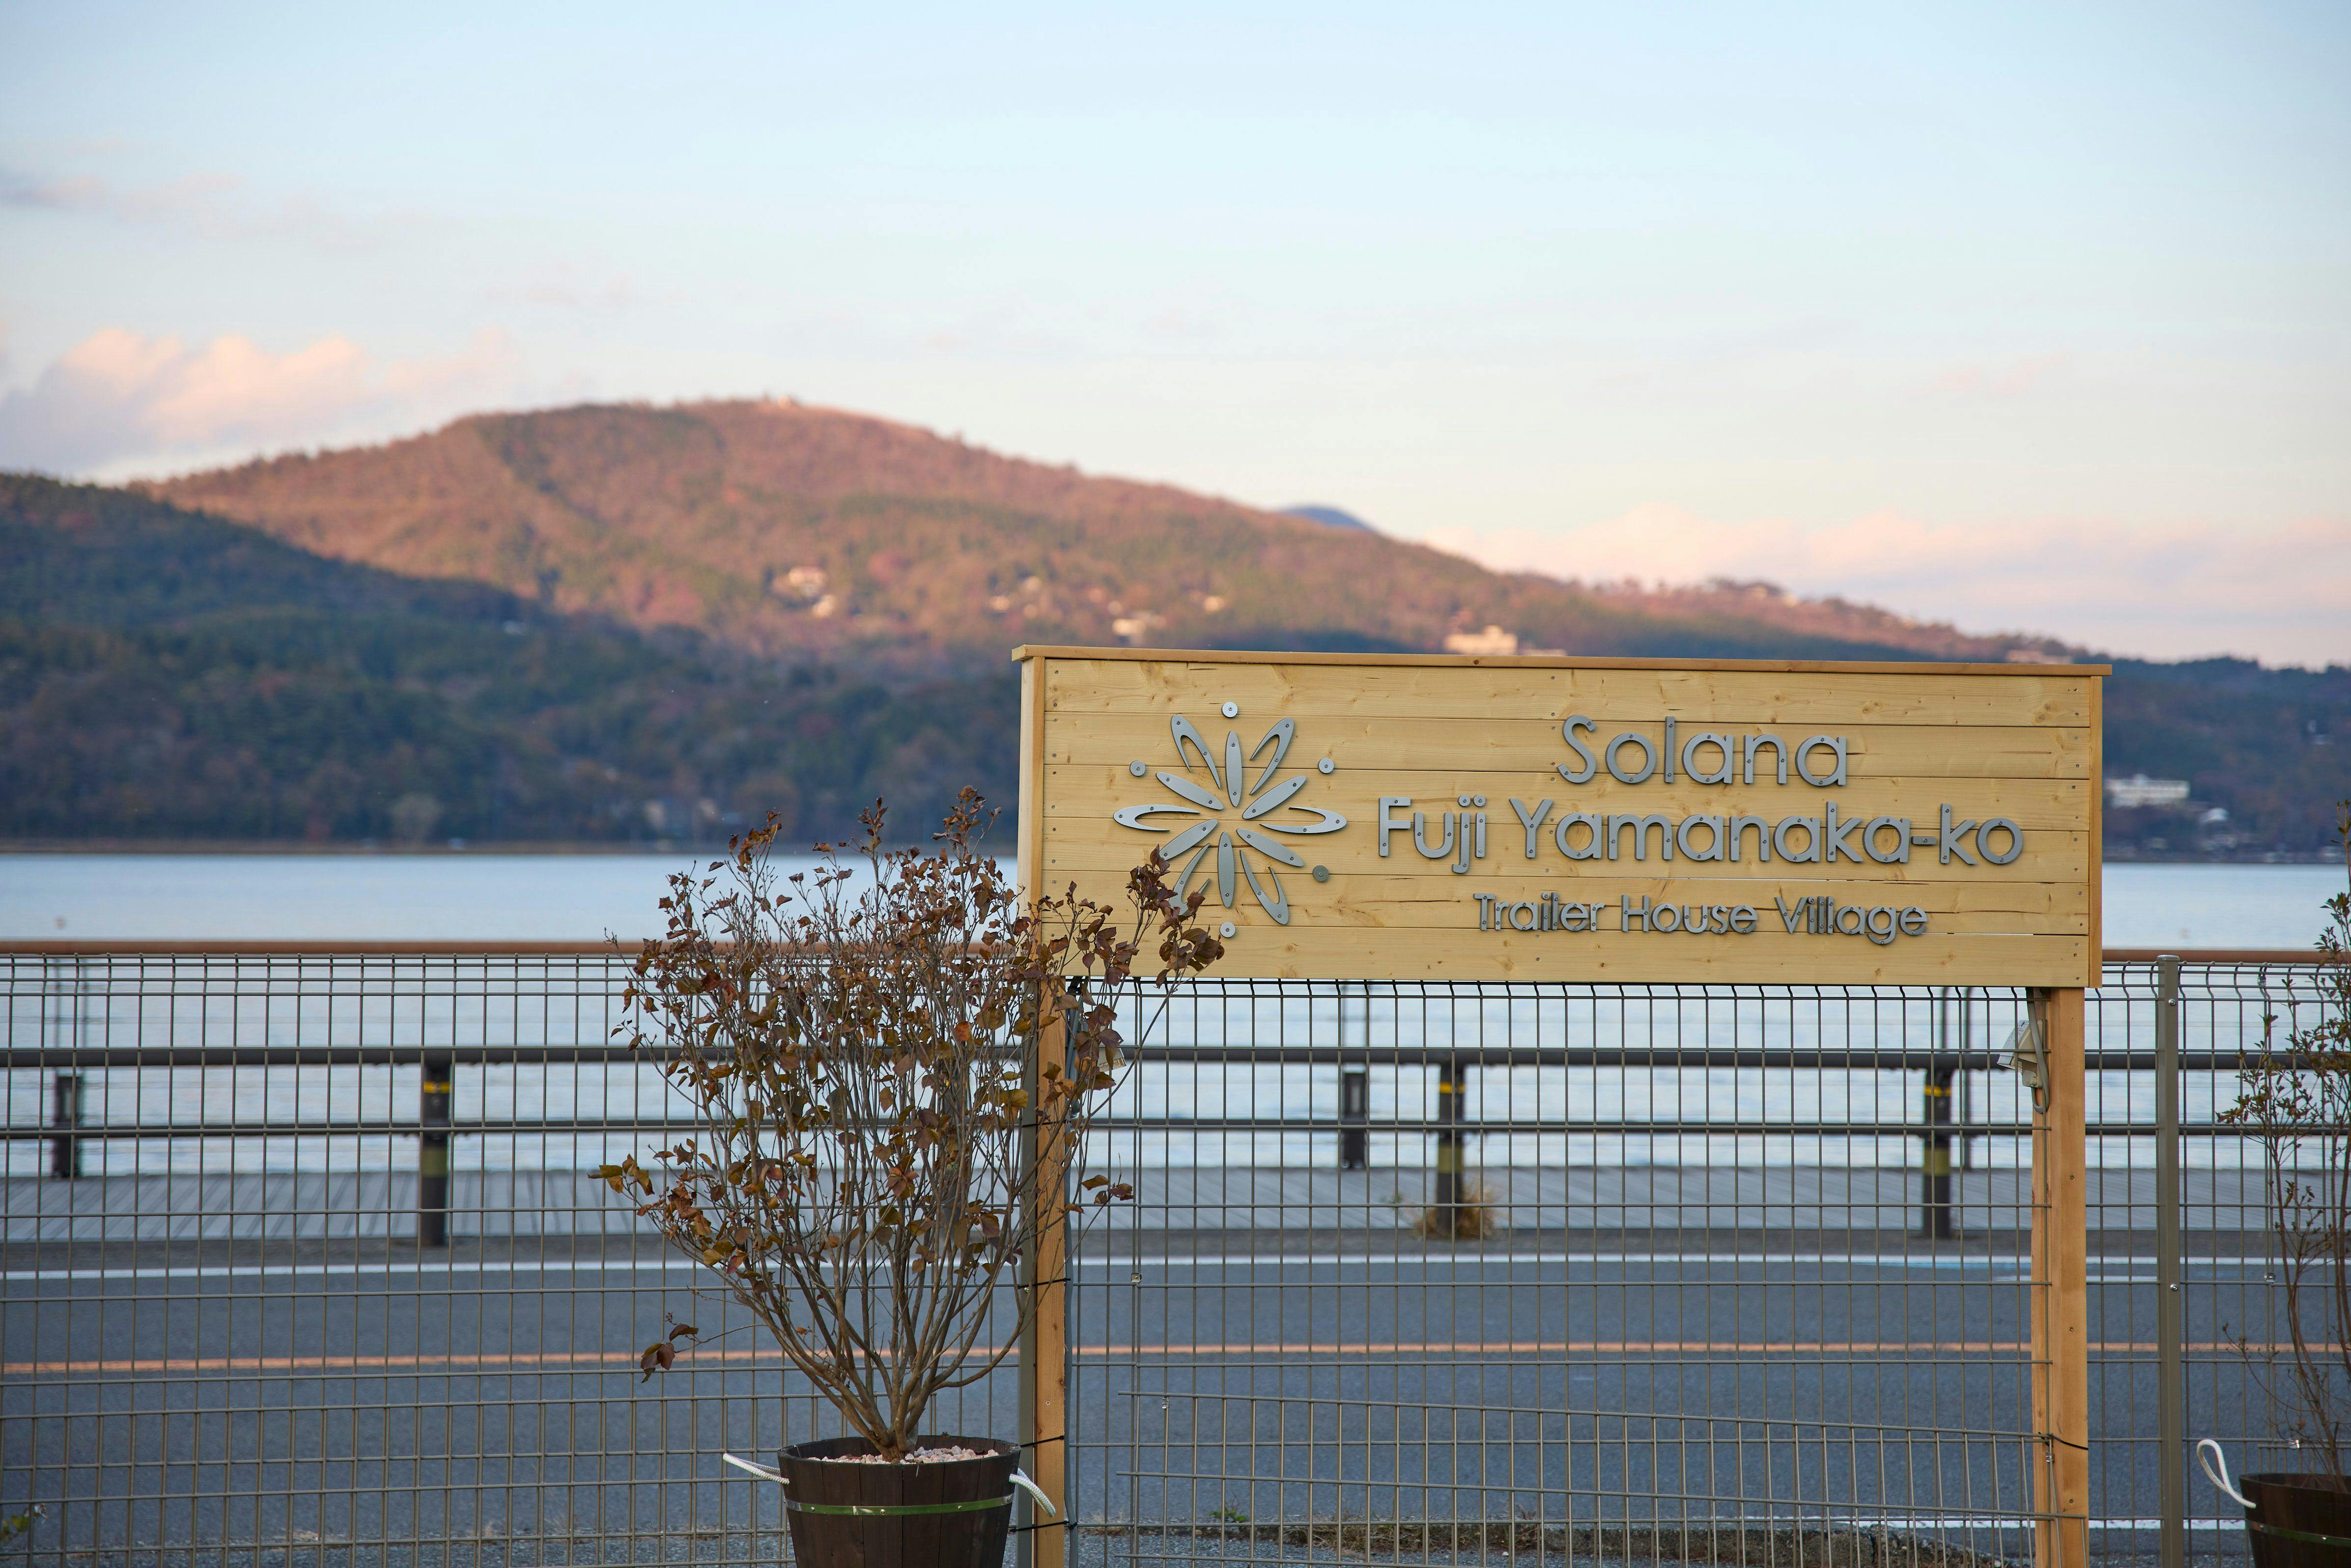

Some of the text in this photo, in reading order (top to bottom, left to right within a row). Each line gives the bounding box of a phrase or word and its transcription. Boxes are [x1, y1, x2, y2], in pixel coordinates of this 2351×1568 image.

[1557, 715, 1848, 787] Solana
[1378, 794, 2024, 874] Fuji Yamanaka-ko
[1473, 892, 1928, 945] Trailer House Village
